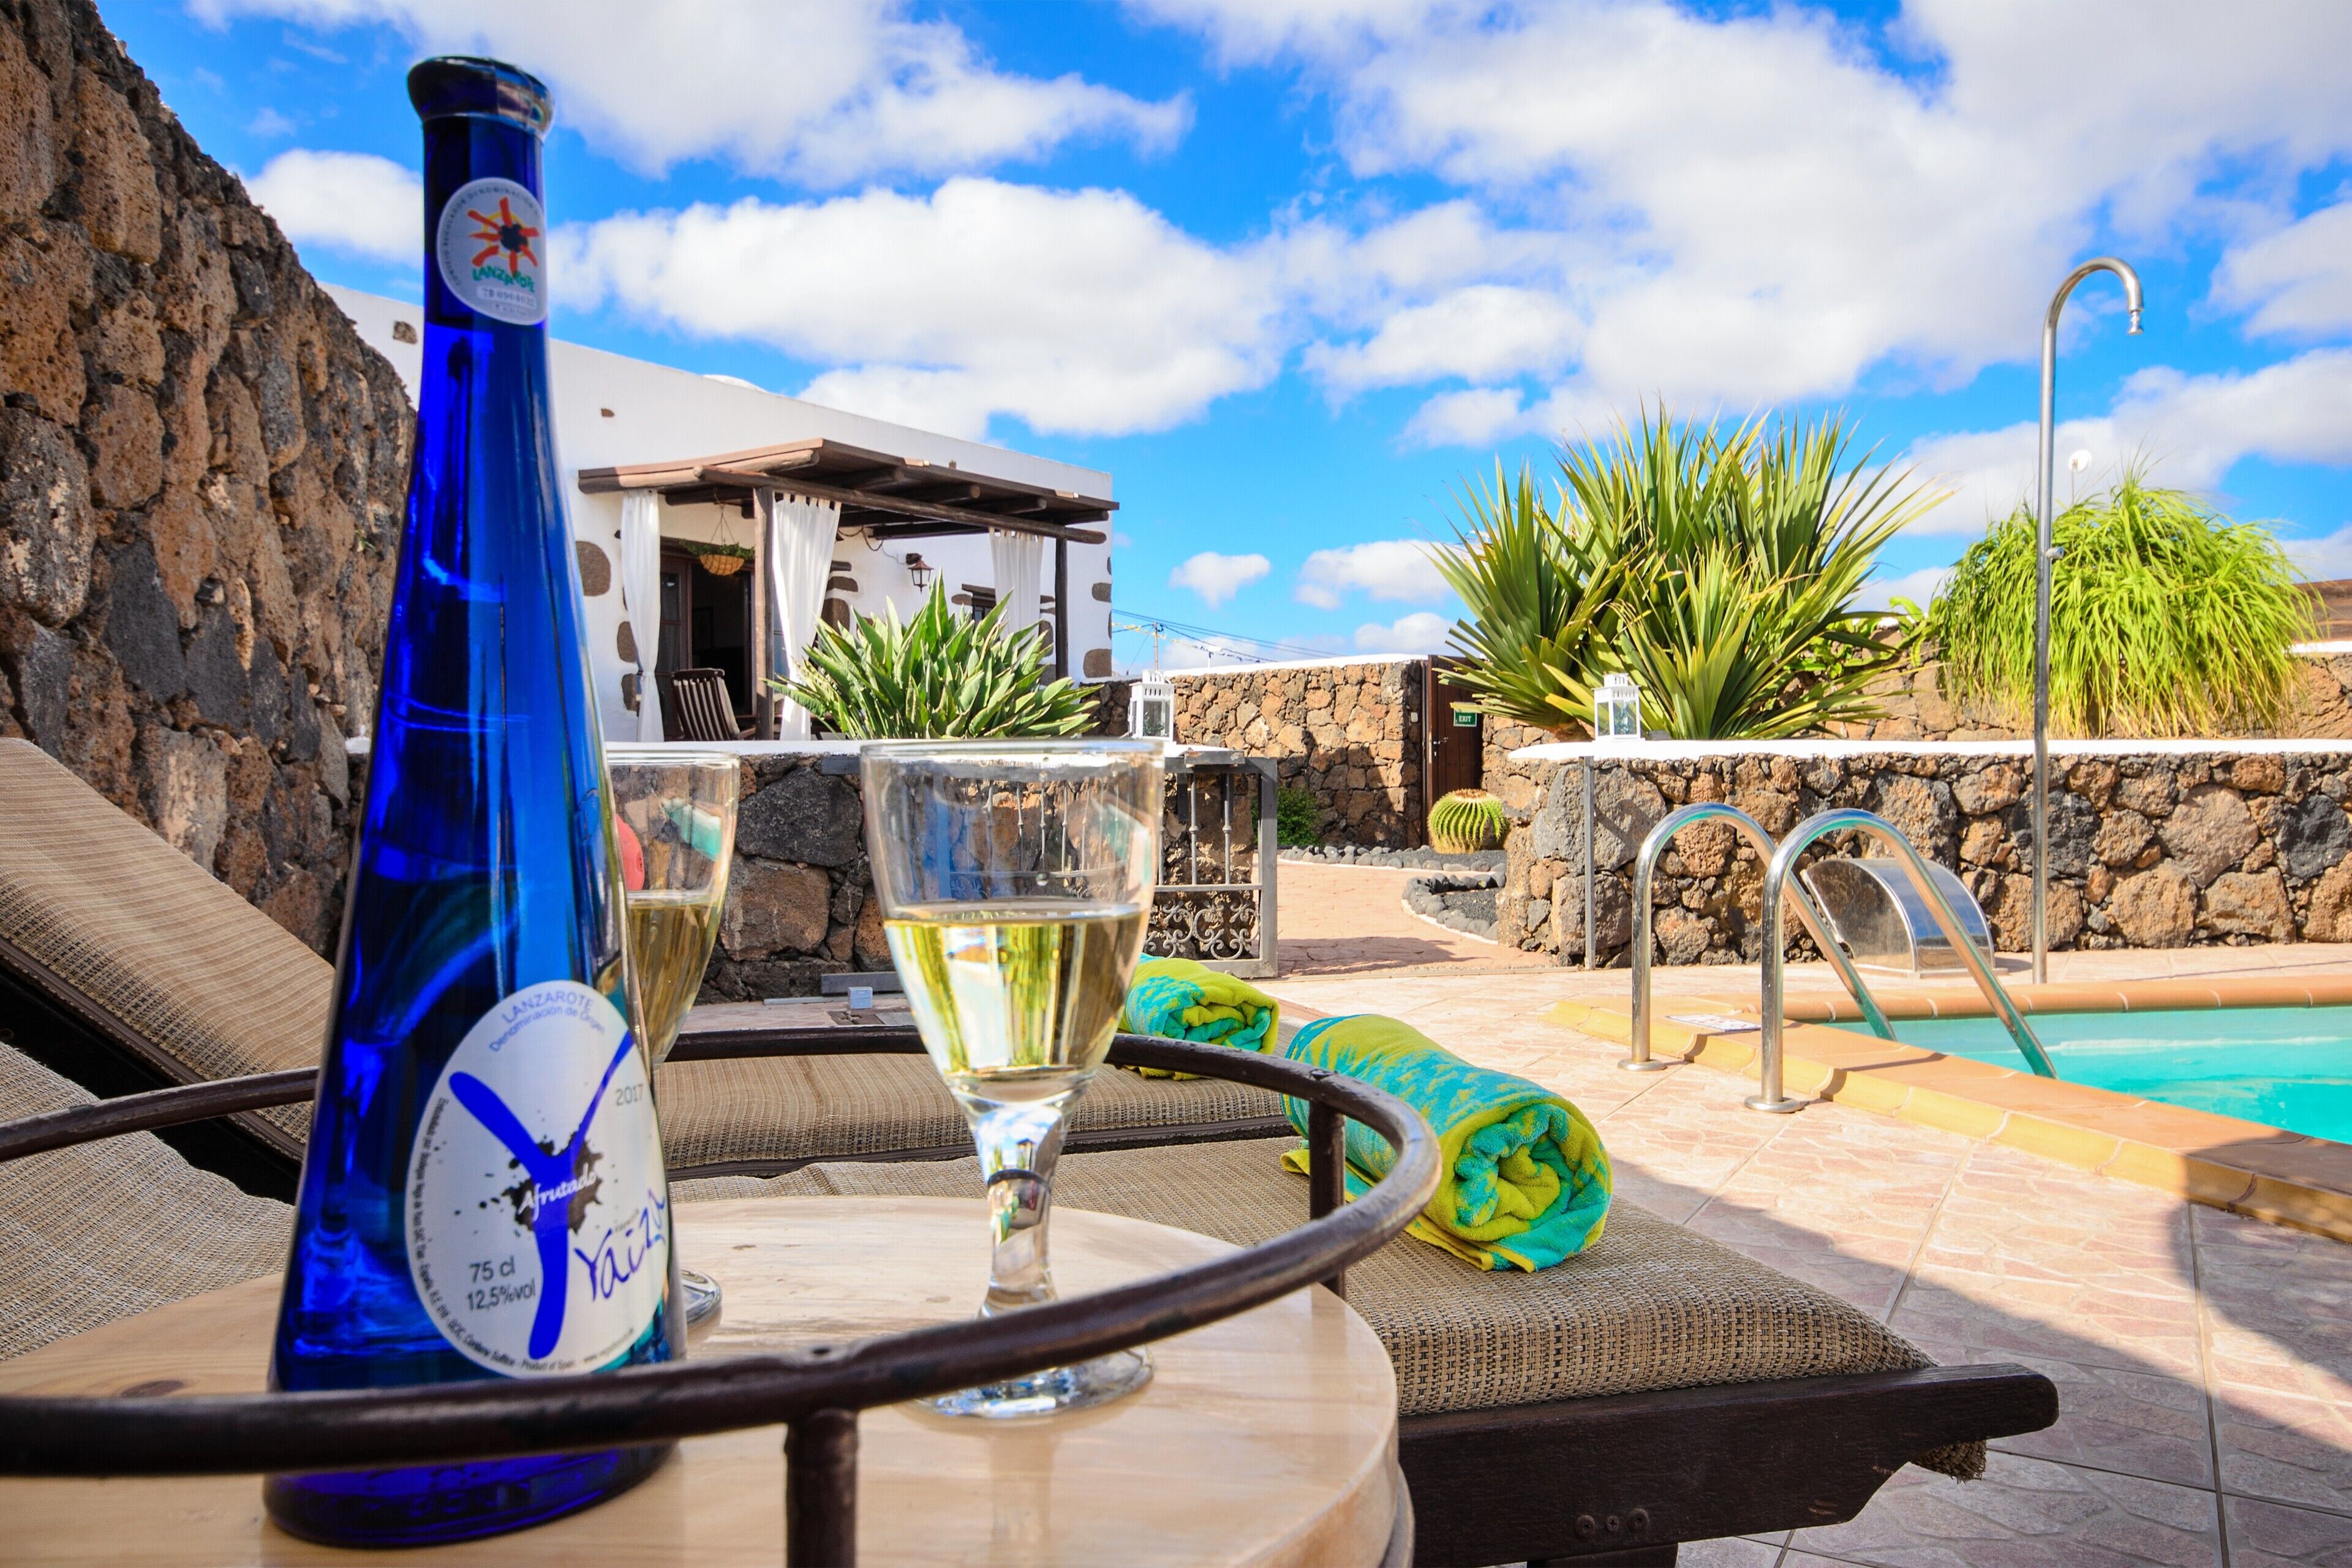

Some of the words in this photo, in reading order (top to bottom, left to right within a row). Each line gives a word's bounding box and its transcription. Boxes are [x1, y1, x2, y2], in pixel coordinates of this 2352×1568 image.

[502, 990, 595, 1024] LANZAROTE
[489, 1005, 563, 1053] Denominación
[564, 1006, 579, 1017] de
[581, 1012, 606, 1035] Origen
[616, 1084, 644, 1106] 2017
[518, 1163, 597, 1223] Afrutado
[469, 1260, 494, 1284] 75
[499, 1254, 515, 1277] cl
[466, 1277, 537, 1313] 12,5%vol
